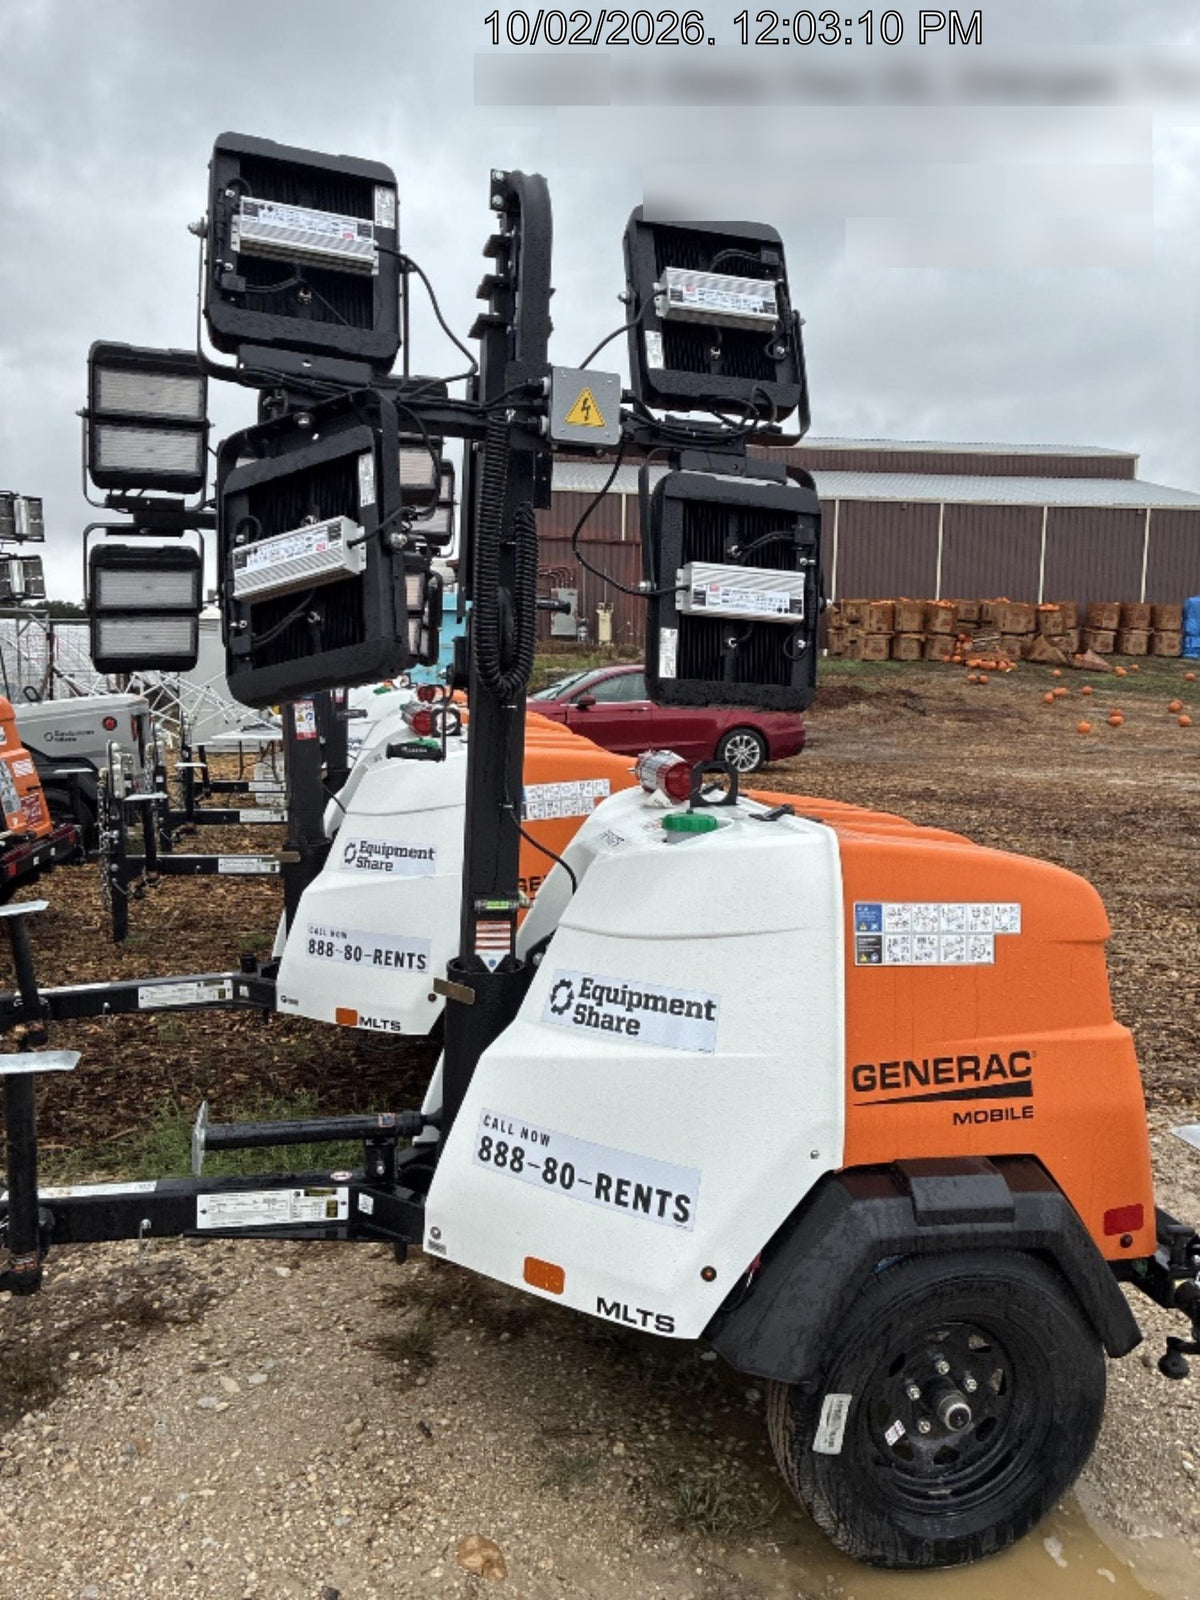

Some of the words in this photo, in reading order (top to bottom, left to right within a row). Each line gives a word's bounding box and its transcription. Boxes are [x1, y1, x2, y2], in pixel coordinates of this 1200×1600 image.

[356, 857, 393, 872] Share
[359, 841, 436, 860] Equipment
[308, 939, 427, 970] 888-80-RENTS
[578, 976, 717, 1022] Equipment
[359, 1016, 401, 1031] MLTS
[572, 1003, 641, 1037] Share
[852, 1050, 1033, 1092] GENERAC
[483, 1114, 515, 1135] CALL
[520, 1126, 551, 1147] NOW
[952, 1105, 1034, 1126] MOBILE
[477, 1135, 692, 1224] 888-80-RENTS
[596, 1296, 675, 1333] MLTS
